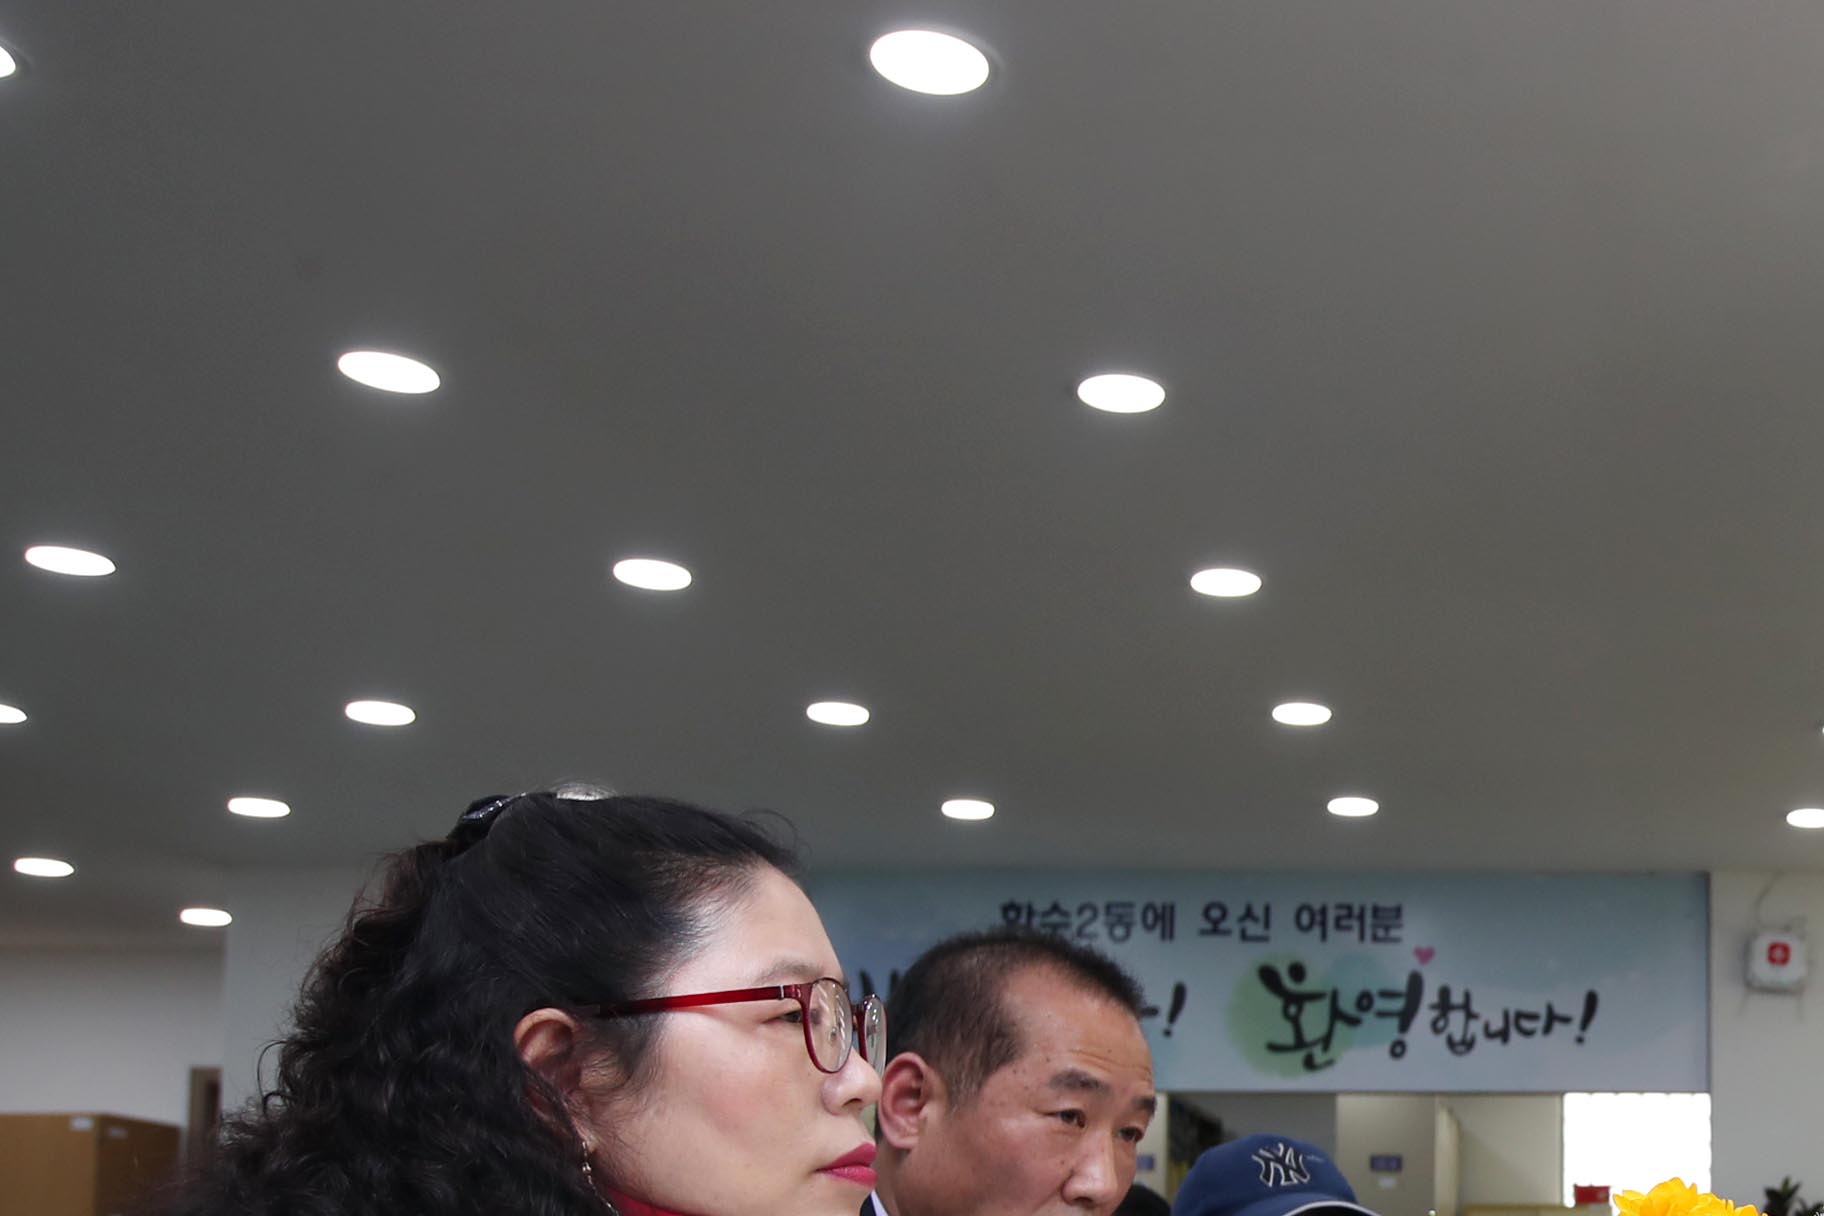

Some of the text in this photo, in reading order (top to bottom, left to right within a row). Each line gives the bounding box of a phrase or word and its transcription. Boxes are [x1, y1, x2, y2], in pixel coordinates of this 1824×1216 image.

[1199, 901, 1271, 943] 오신
[1295, 901, 1404, 943] 여러분
[1258, 962, 1598, 1072] 환영합니다!
[1252, 1142, 1310, 1187] NY
